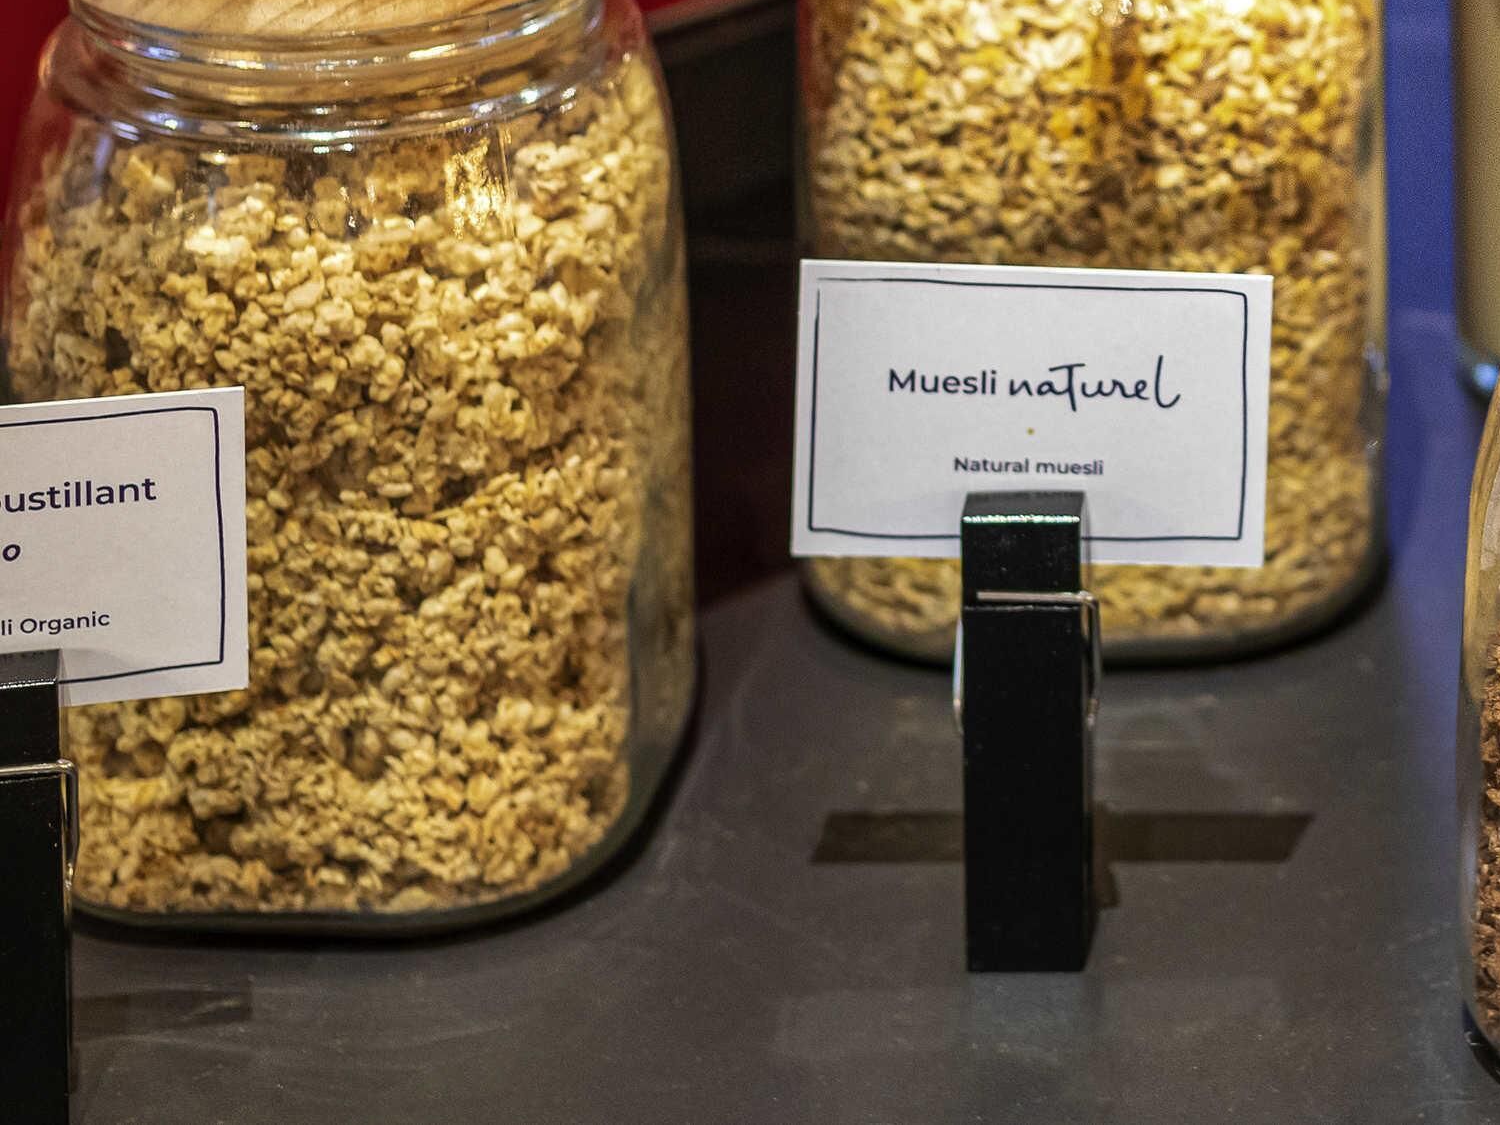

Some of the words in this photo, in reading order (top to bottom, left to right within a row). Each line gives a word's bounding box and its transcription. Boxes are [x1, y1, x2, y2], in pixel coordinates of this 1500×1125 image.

[888, 368, 997, 396] Muesli
[953, 456, 1030, 475] Natural
[1035, 459, 1104, 476] muesli
[0, 478, 157, 513] ustillant
[19, 611, 111, 636] Organic
